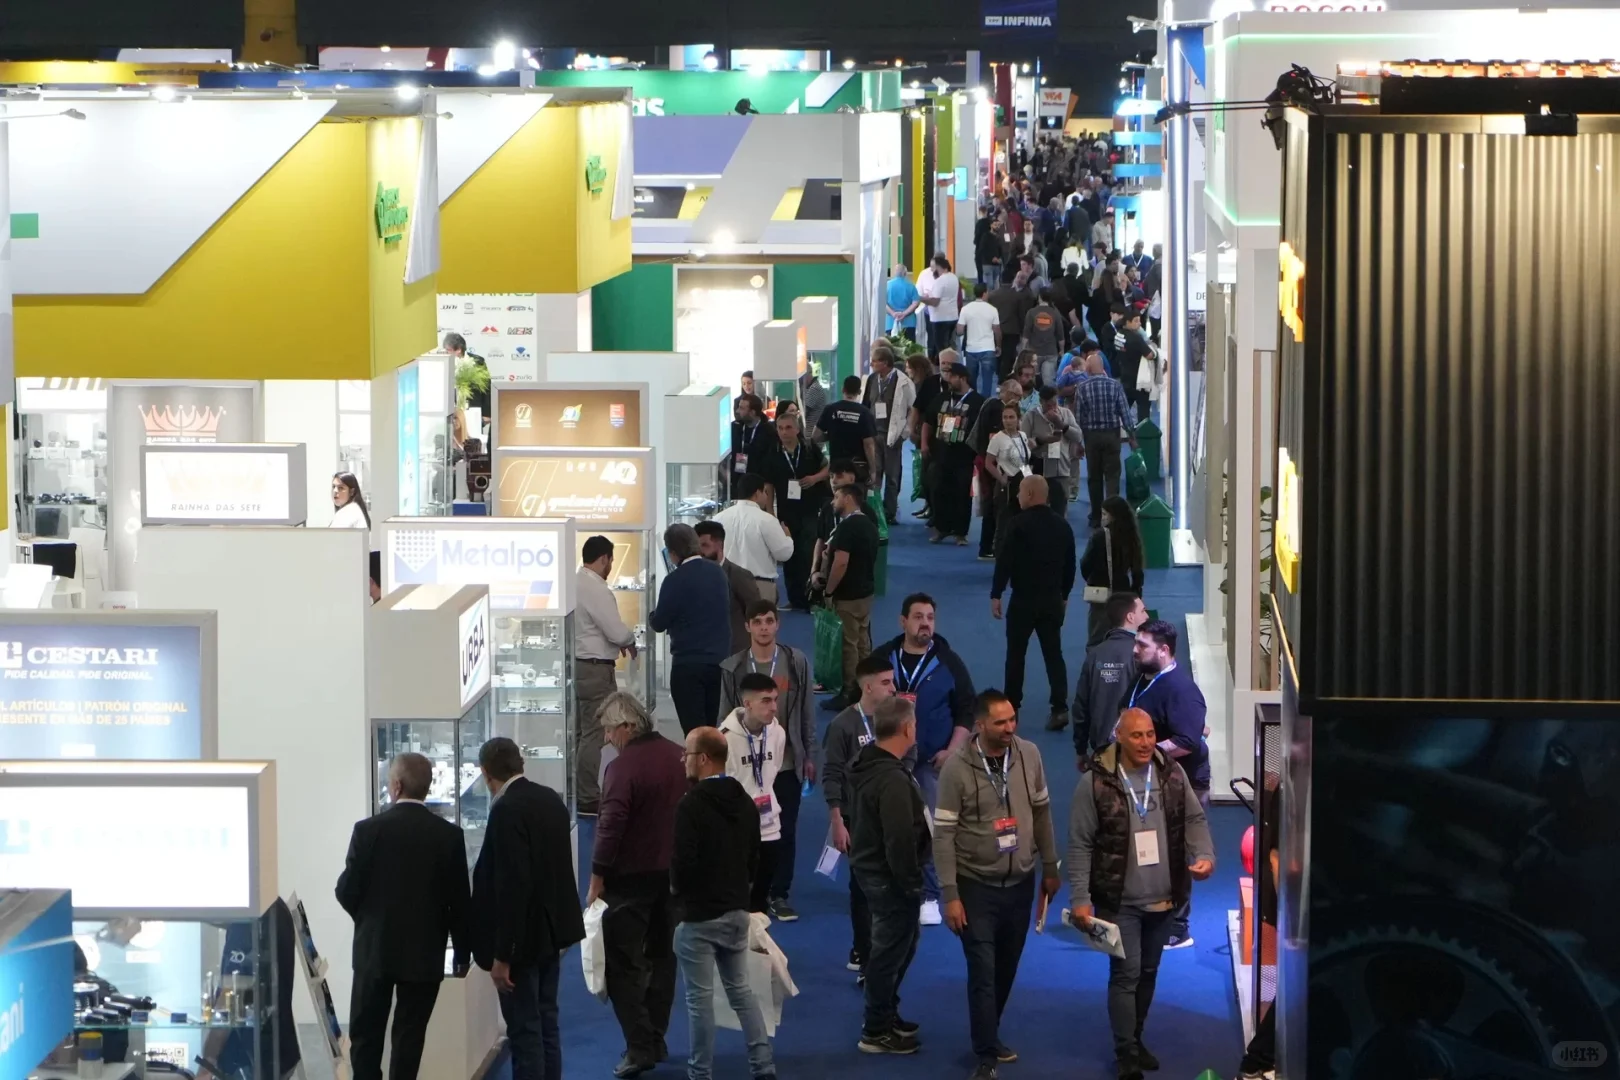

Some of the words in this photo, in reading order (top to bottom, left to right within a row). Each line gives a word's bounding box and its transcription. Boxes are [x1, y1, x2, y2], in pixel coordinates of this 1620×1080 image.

[1004, 16, 1052, 27] INFINIA
[171, 503, 210, 512] RAINHA
[216, 503, 235, 512] DAS
[240, 503, 261, 512] SETE
[442, 540, 554, 573] Metalpó
[462, 614, 485, 686] URBA
[27, 647, 158, 665] CESTARI
[4, 669, 28, 679] PIDE
[78, 670, 102, 680] PIDE
[85, 700, 130, 712] PATRÓN
[133, 702, 187, 712] ORIGINAL
[96, 714, 112, 725] DE
